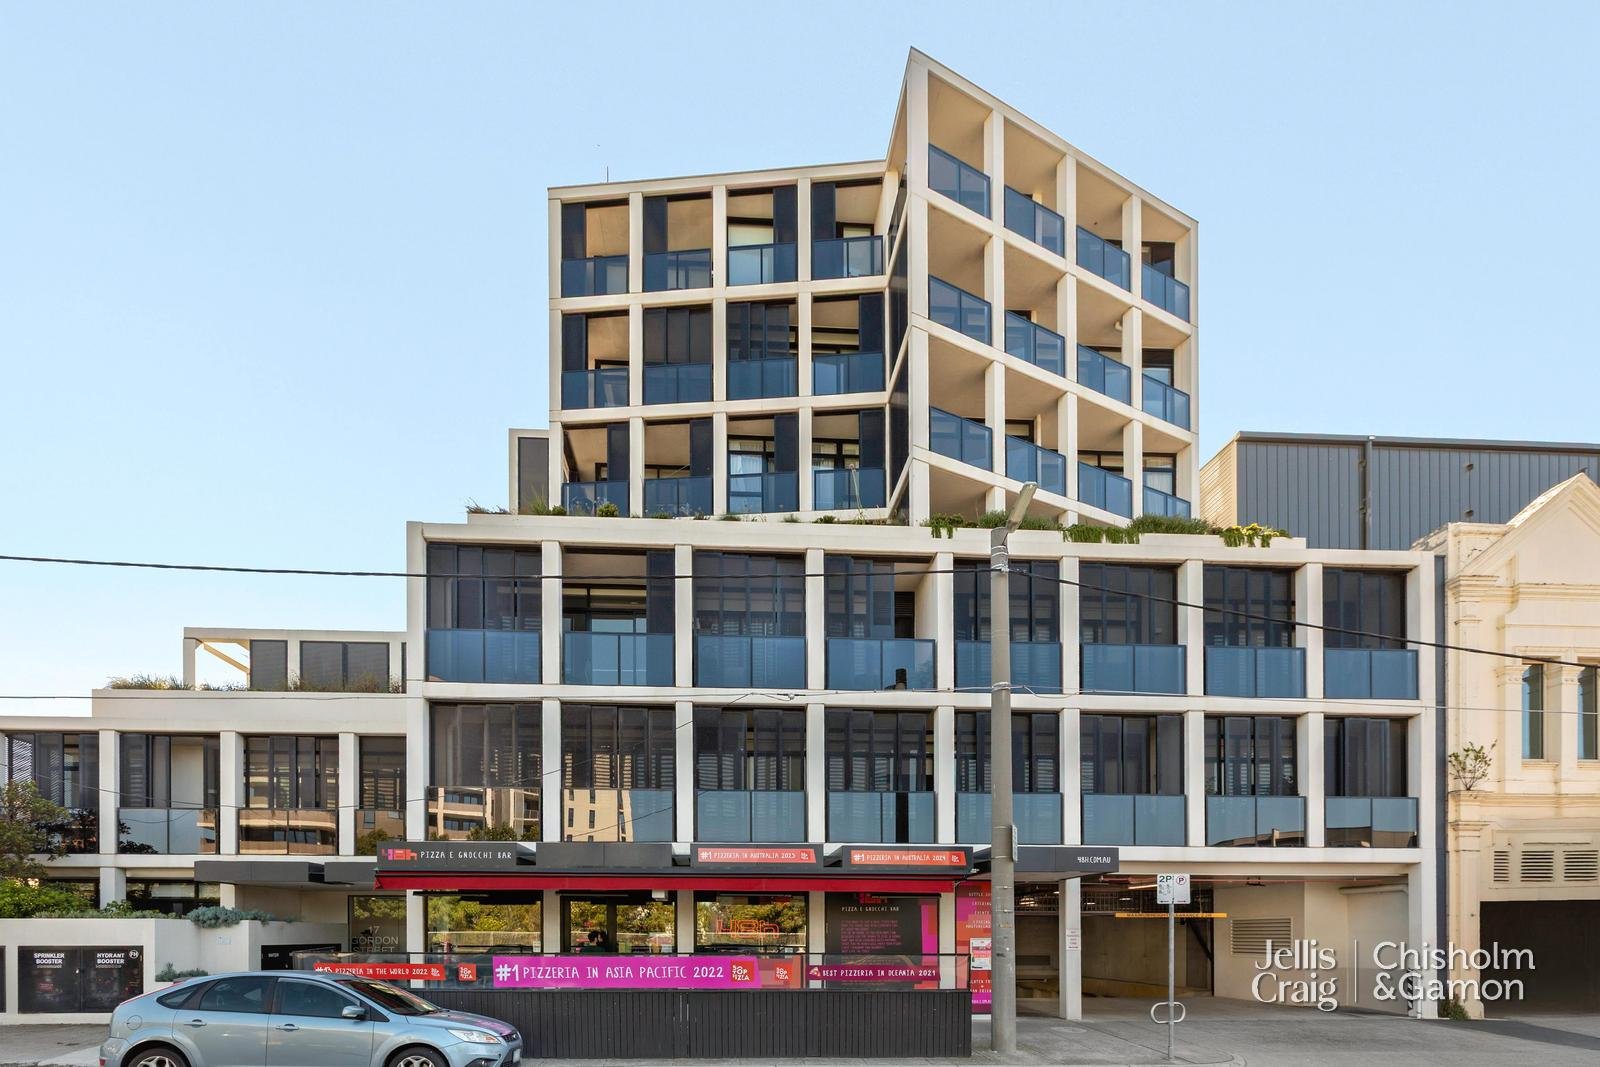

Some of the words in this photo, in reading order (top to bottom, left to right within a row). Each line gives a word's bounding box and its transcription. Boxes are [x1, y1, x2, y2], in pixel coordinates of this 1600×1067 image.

[420, 851, 445, 859] PIZZA
[449, 851, 454, 859] E
[458, 851, 492, 859] GNOCCHI
[497, 851, 512, 859] BAR
[700, 851, 712, 860] #1
[853, 854, 865, 862] #1
[369, 926, 380, 934] 17
[352, 936, 399, 945] GORDON
[335, 967, 364, 975] PIZZERIA
[495, 964, 519, 981] #1
[523, 966, 580, 979] PIZZERIA
[586, 966, 599, 979] IN
[605, 966, 634, 979] ASIA
[639, 966, 687, 979] PACIFIC
[693, 966, 724, 978] 2022
[822, 969, 837, 977] BEST
[840, 969, 874, 977] PIZZERIA
[877, 969, 885, 977] IN
[888, 969, 915, 977] OCEANIA
